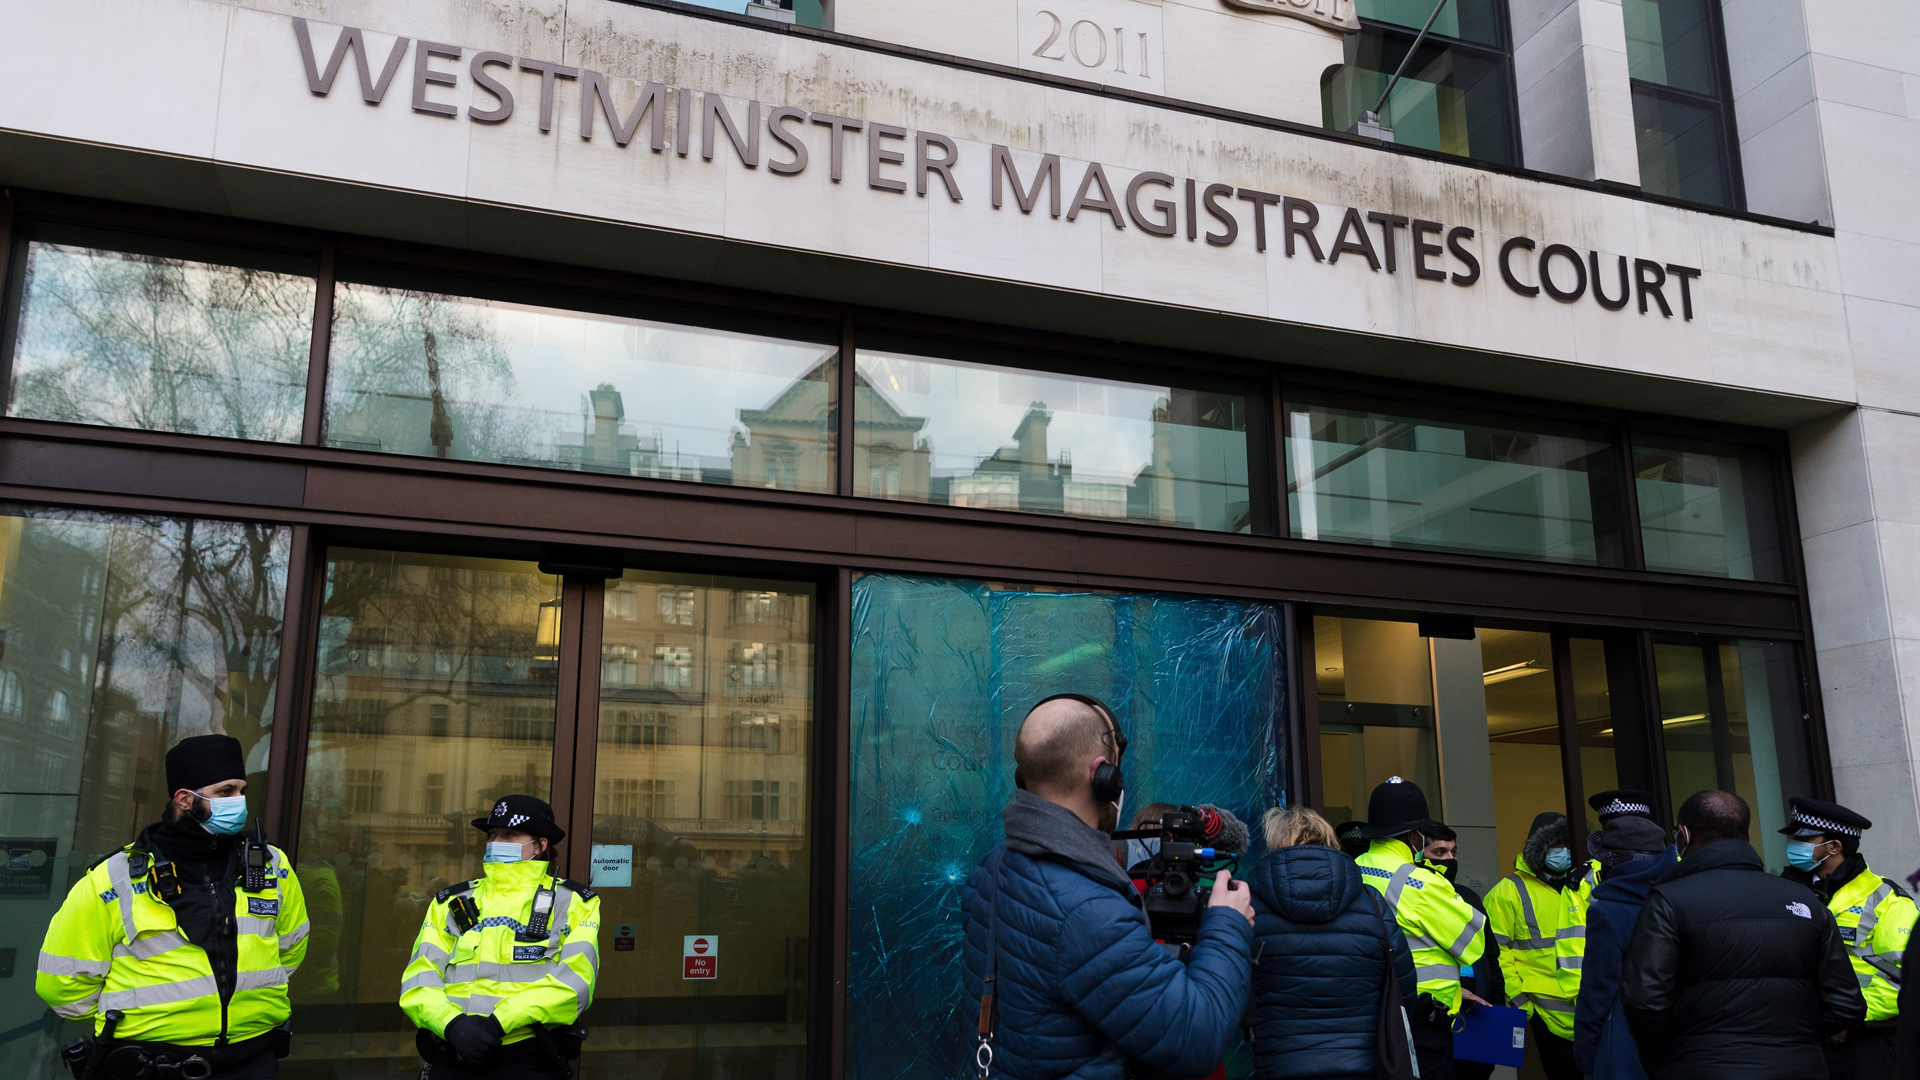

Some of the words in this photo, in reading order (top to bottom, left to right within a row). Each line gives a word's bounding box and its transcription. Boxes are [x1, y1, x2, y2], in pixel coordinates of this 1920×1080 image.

[1032, 10, 1151, 79] 2011
[292, 17, 964, 201] WESTMINSTER
[990, 143, 1481, 287] MAGISTRATES
[1499, 235, 1702, 321] COURT
[689, 967, 711, 976] entry
